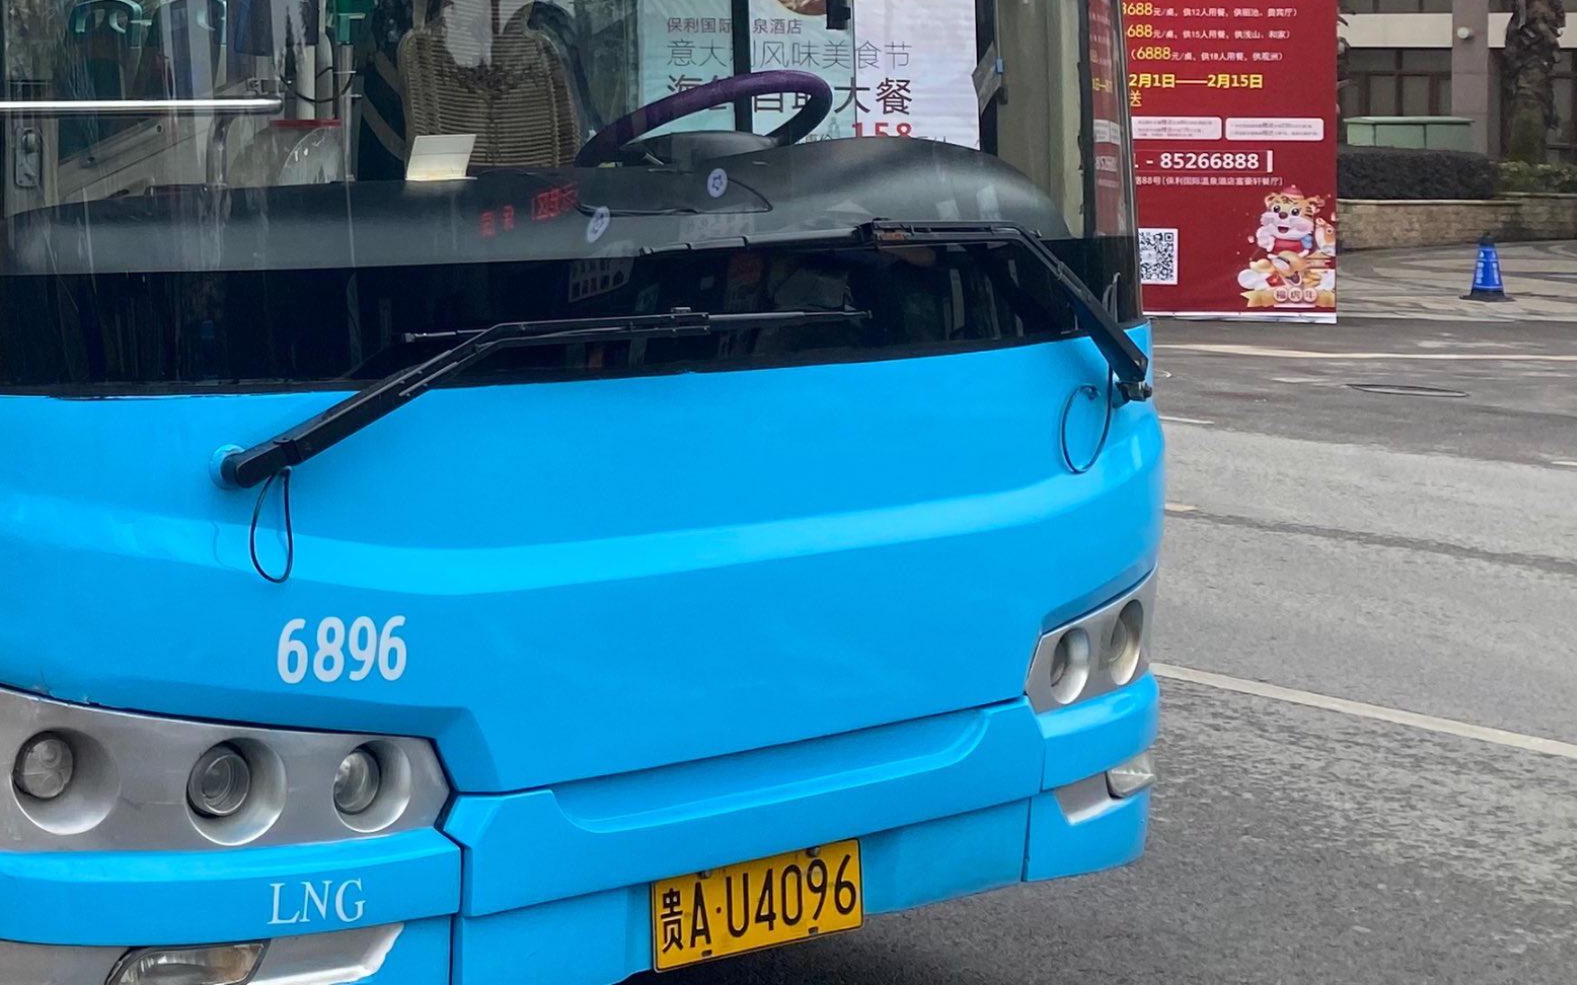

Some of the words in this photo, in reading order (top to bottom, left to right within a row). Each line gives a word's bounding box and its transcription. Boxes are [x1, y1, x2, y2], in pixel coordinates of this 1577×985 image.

[667, 17, 803, 34] 保利国际泉酒店
[1159, 152, 1260, 169] 85266888
[277, 615, 408, 684] 6896
[268, 878, 367, 925] LNG
[660, 853, 857, 954] 贵A·U4096
